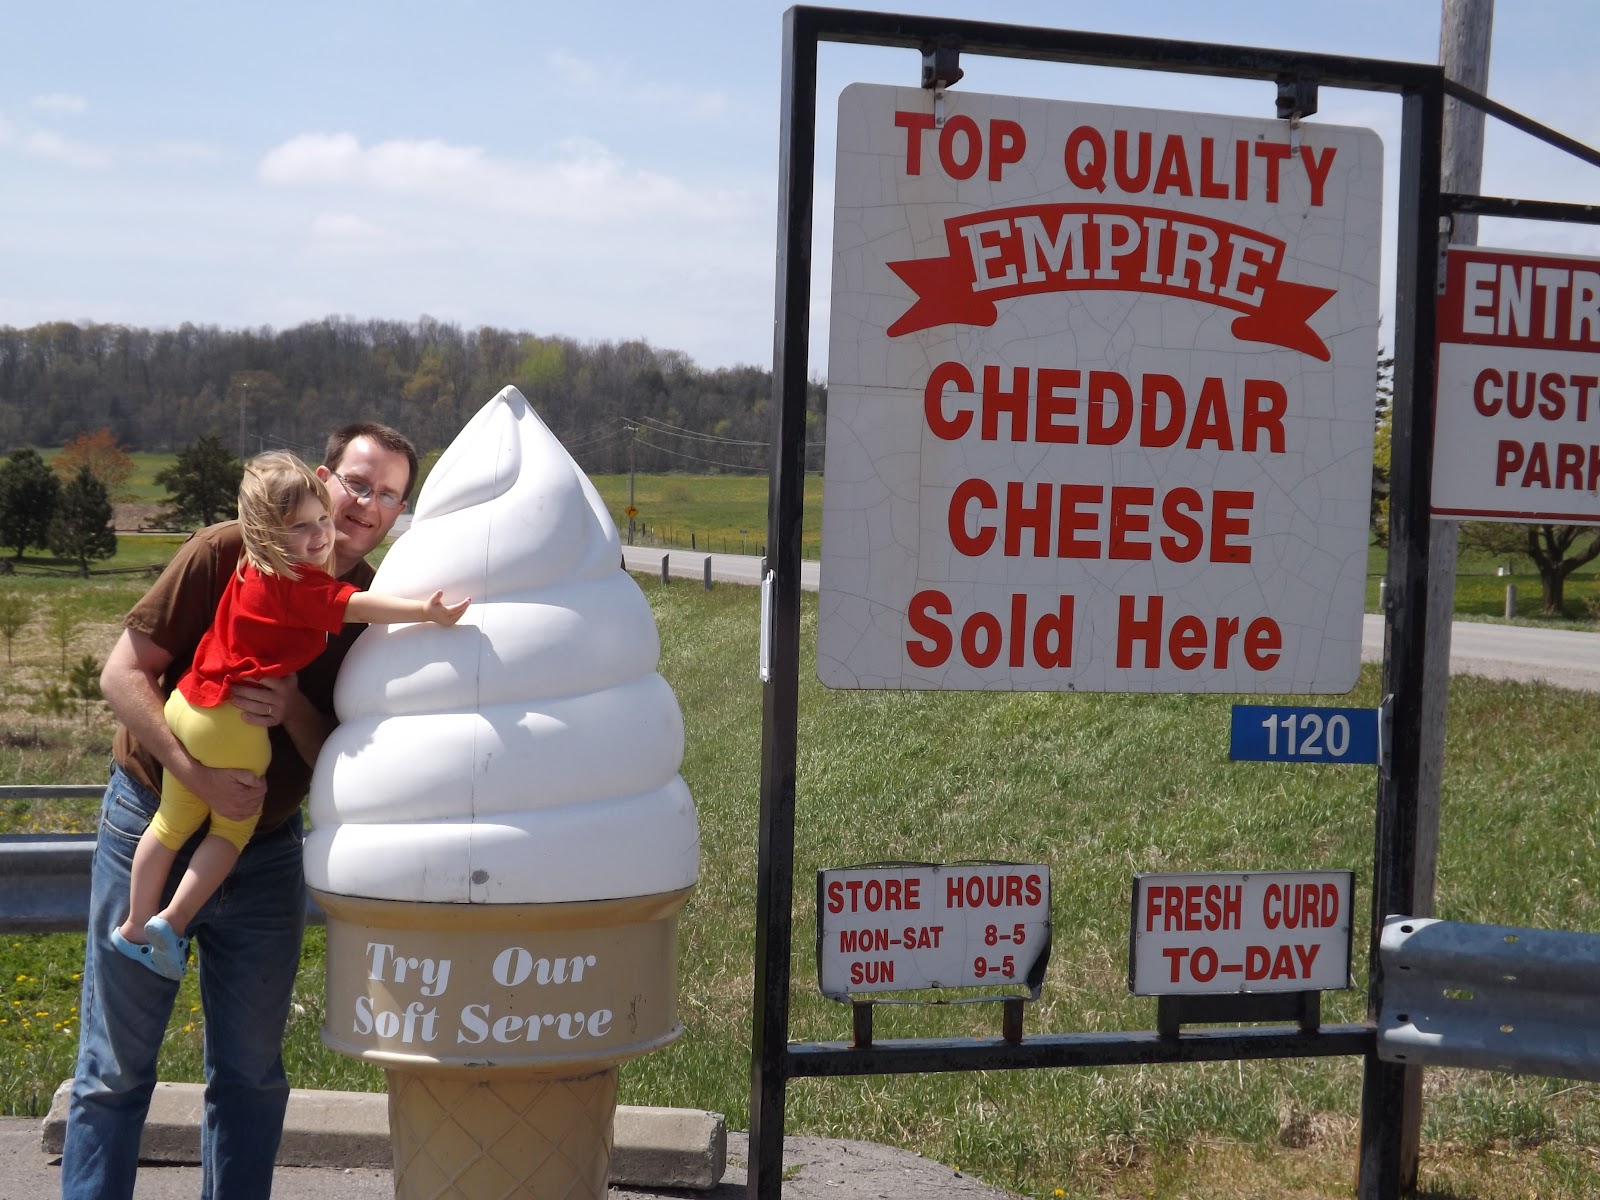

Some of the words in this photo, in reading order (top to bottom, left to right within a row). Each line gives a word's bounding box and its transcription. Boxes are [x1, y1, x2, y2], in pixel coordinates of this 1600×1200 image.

[895, 111, 1026, 181] TOP
[1064, 126, 1337, 206] QUALITY
[959, 213, 1275, 307] EMPIRE
[1462, 262, 1600, 343] ENTR
[924, 361, 1288, 453] CHEDDAR
[1473, 368, 1600, 421] CUST
[948, 478, 1255, 564] CHEESE
[906, 590, 1075, 668] Sold
[1116, 595, 1282, 671] Here
[1261, 713, 1350, 756] 1120
[827, 878, 921, 913] STORE
[947, 874, 1042, 909] HOURS
[1145, 886, 1242, 932] FRESH
[1263, 883, 1339, 929] CURD
[840, 926, 944, 953] MON-SAT
[984, 923, 1026, 945] 8-5
[1163, 944, 1321, 983] TO-DAY
[365, 942, 451, 997] Try
[492, 946, 596, 987] Our
[850, 960, 894, 985] SUN
[974, 956, 1015, 979] 9-5
[353, 996, 440, 1043] Soft
[457, 1004, 612, 1044] Serve
